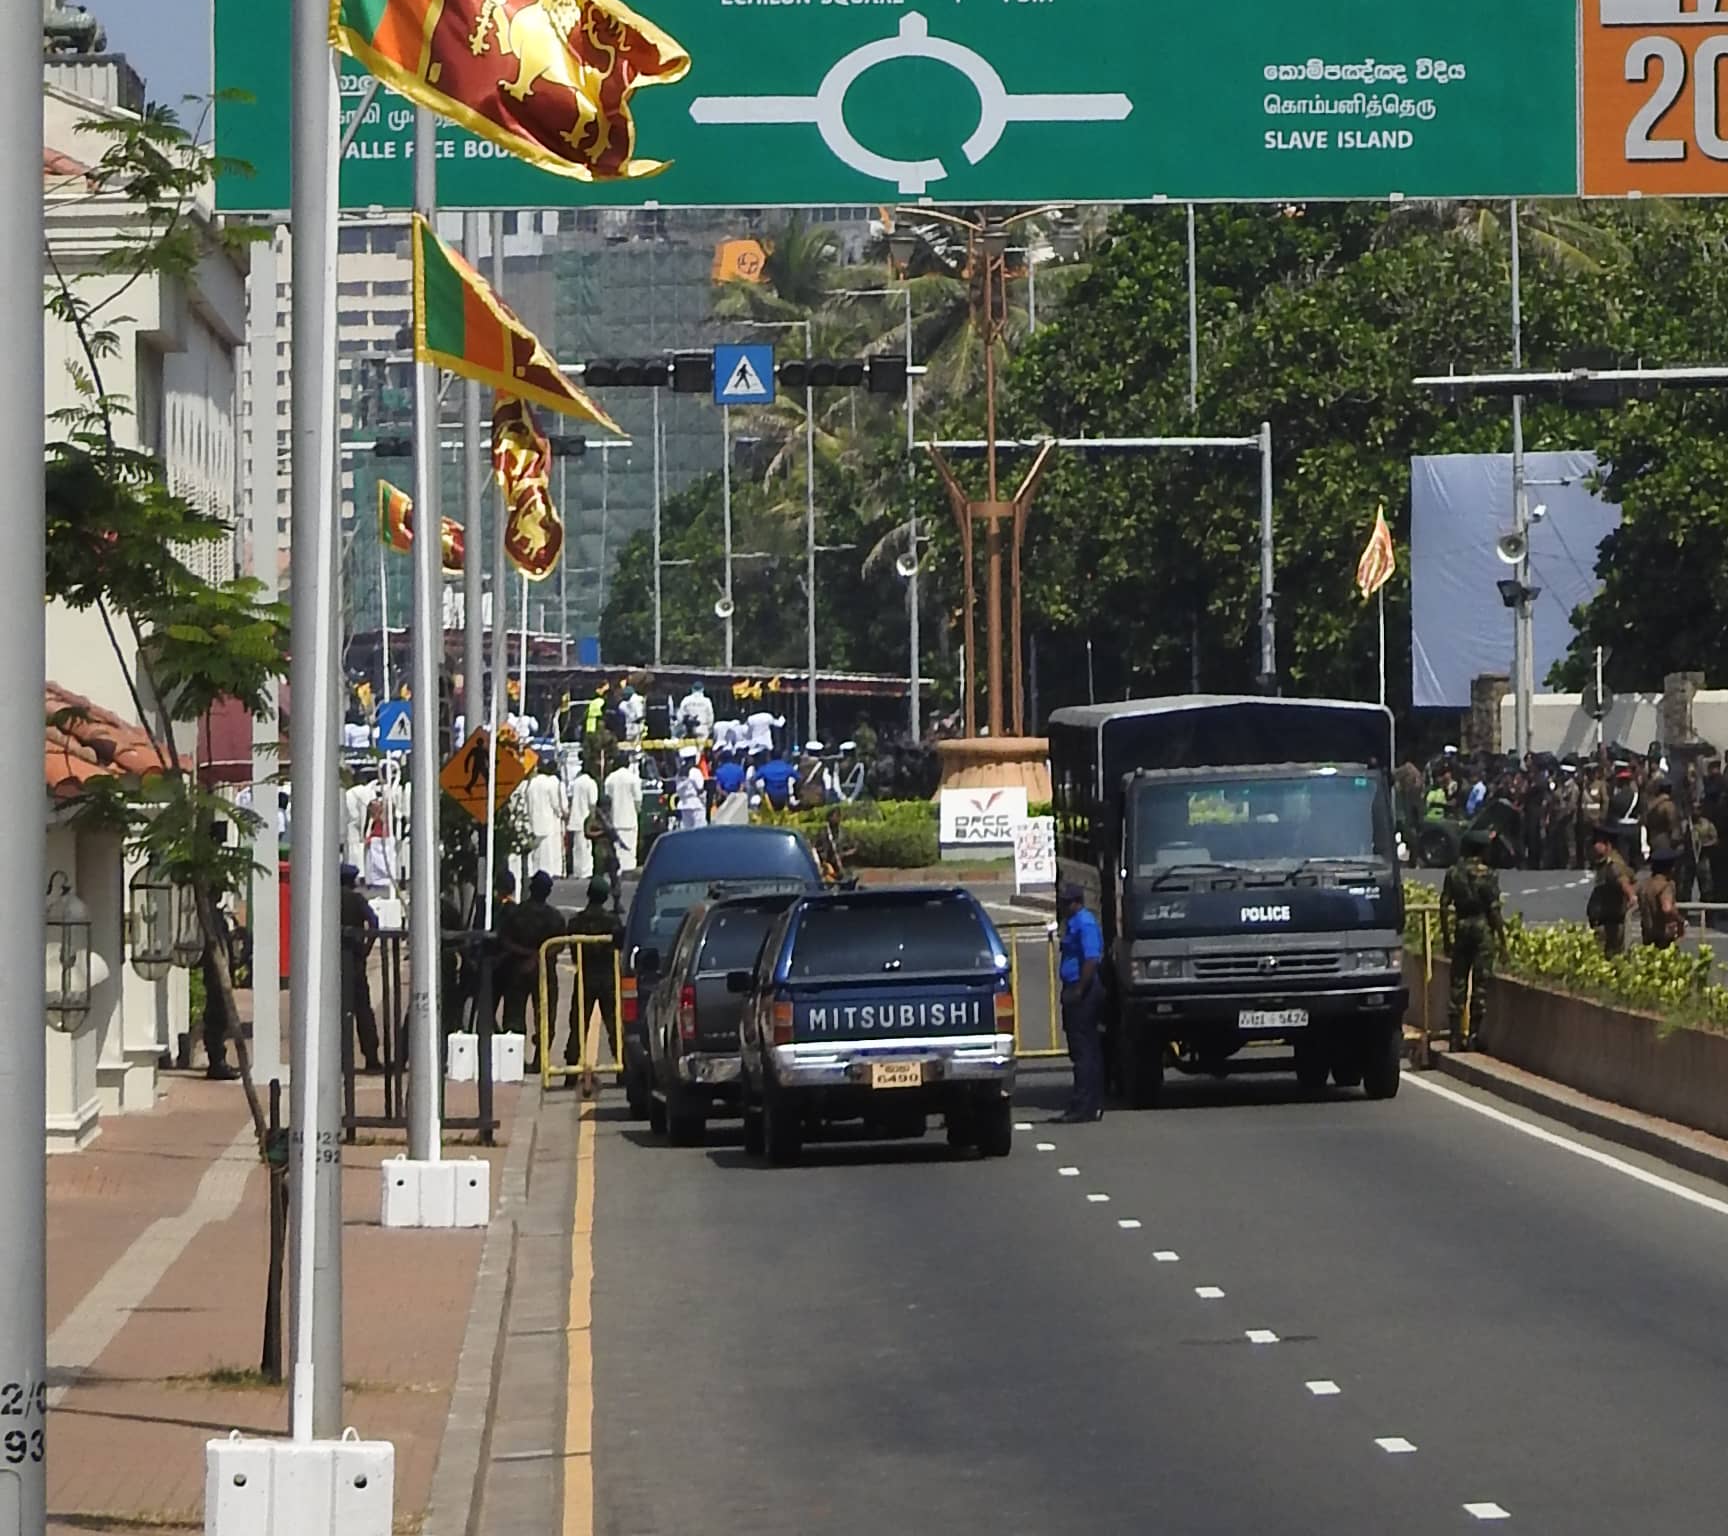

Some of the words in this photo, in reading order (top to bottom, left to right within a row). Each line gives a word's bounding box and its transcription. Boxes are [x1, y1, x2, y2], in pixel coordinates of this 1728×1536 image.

[1264, 130, 1328, 149] SLAVE
[1337, 130, 1414, 149] ISLAND
[345, 141, 396, 159] ALLE
[405, 140, 455, 159] FCE
[955, 828, 1012, 839] BANK
[1241, 906, 1290, 922] POLICE
[809, 1001, 980, 1031] MITSUBISHI
